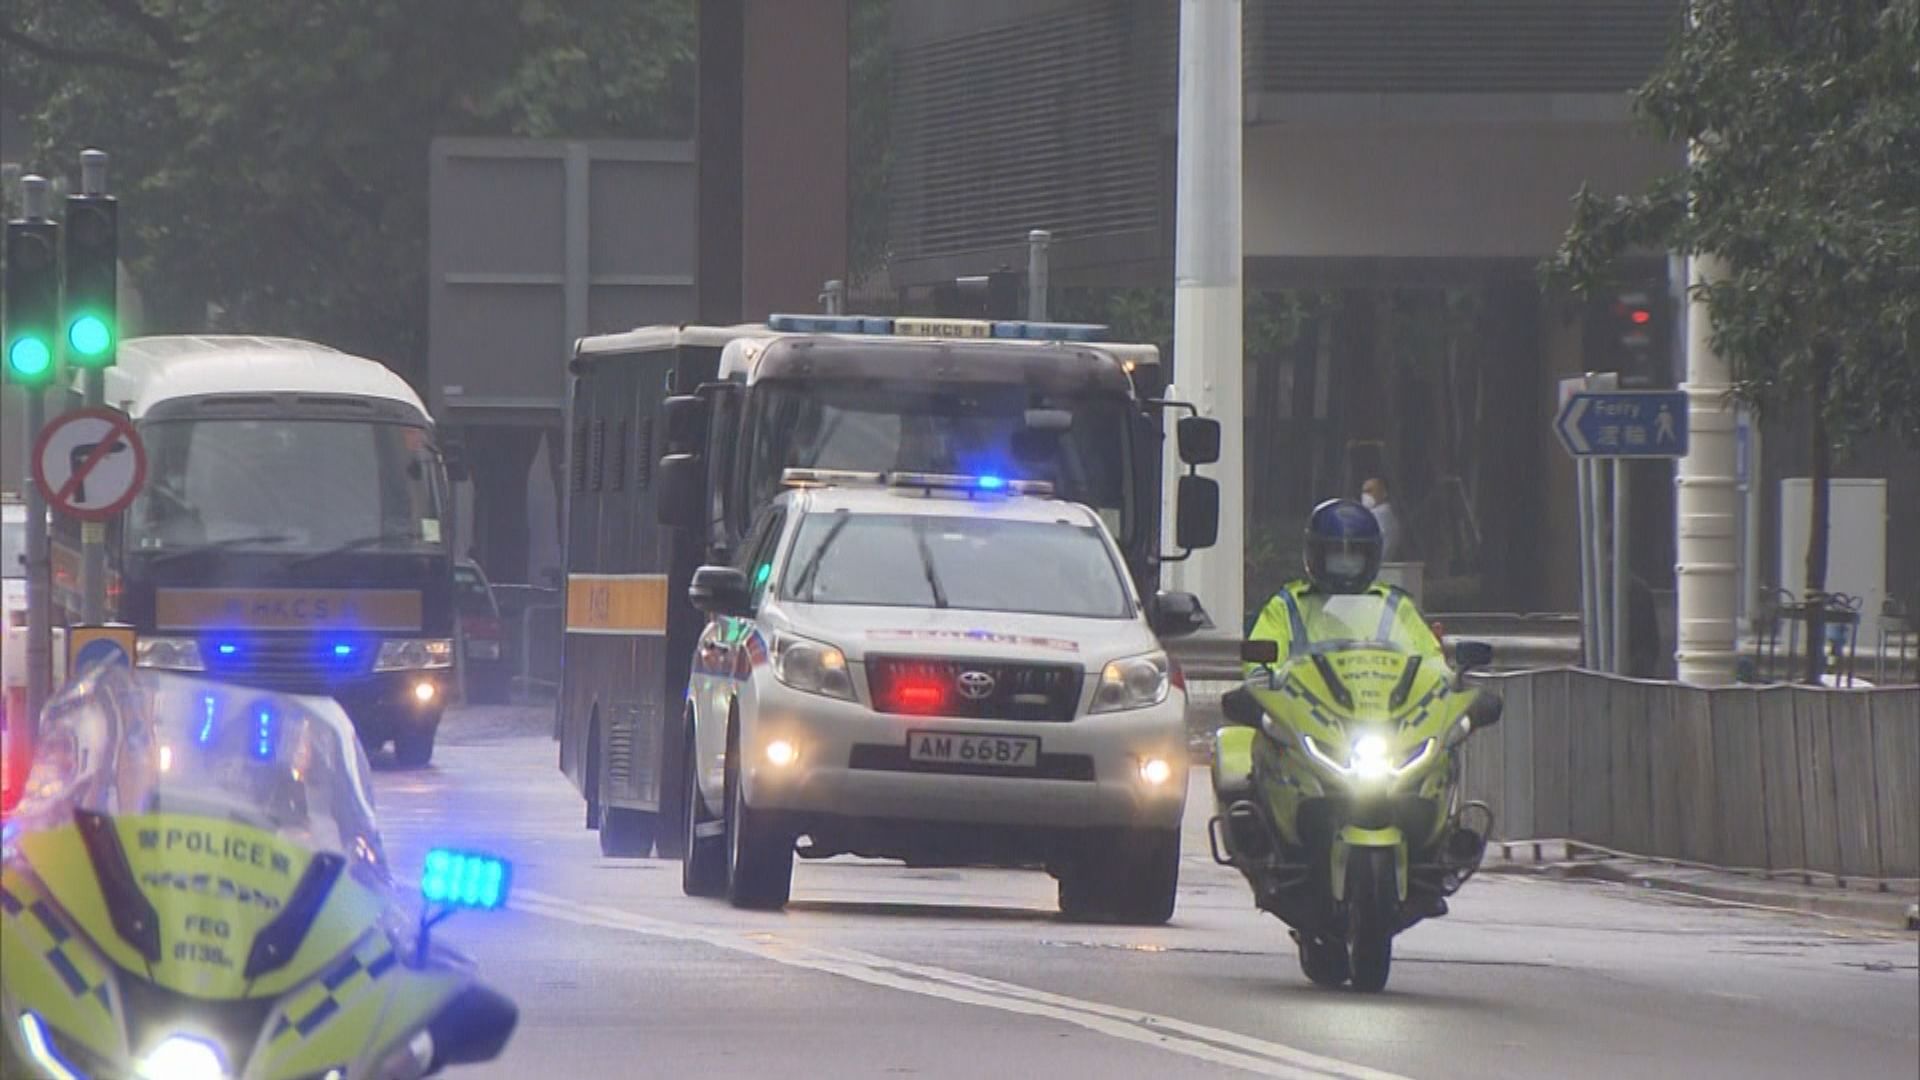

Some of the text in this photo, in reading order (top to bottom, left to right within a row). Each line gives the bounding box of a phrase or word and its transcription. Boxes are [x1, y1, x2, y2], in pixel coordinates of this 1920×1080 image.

[1594, 400, 1641, 419] Ferry
[251, 598, 330, 621] HKCS
[917, 736, 953, 759] AM
[166, 828, 266, 869] POLICE
